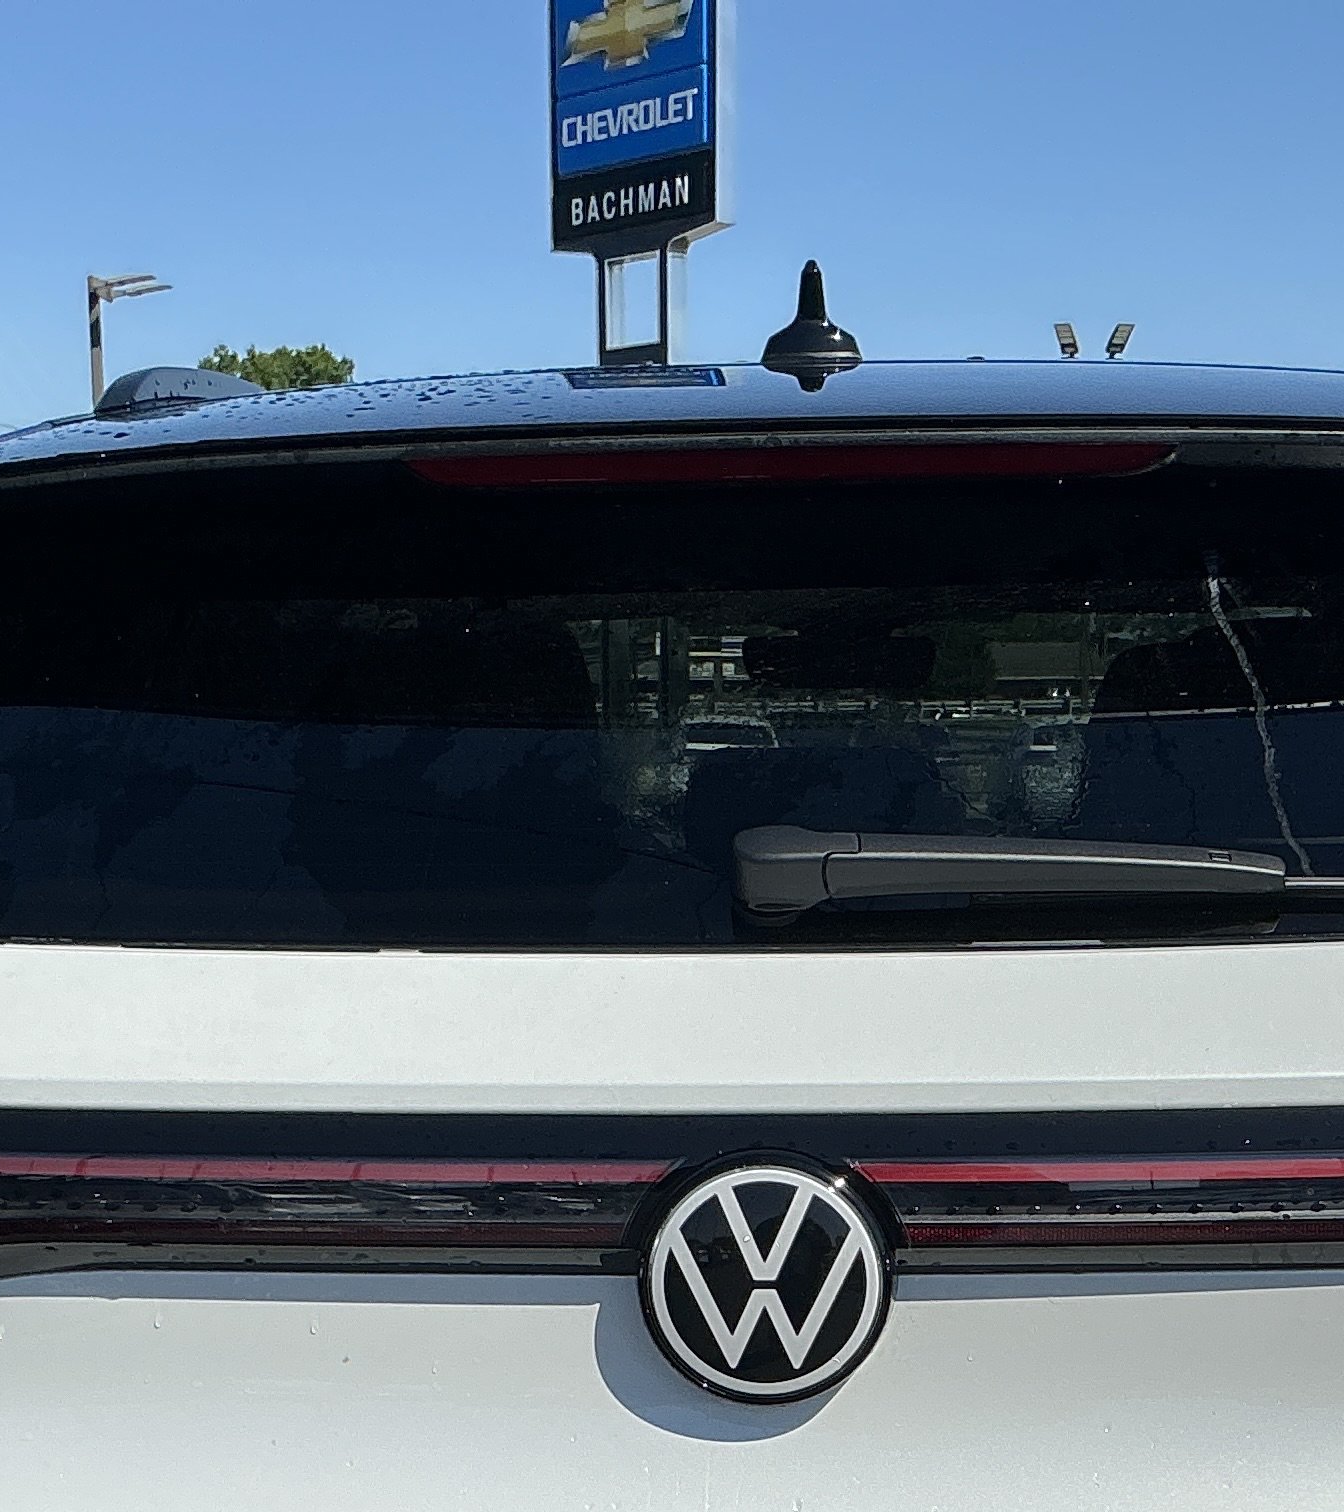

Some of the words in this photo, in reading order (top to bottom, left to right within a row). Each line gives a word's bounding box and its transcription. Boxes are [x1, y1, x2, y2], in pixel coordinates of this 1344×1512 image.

[561, 87, 698, 148] CHEVROLET
[571, 175, 690, 226] BACHMAN
[660, 1176, 872, 1378] VW
